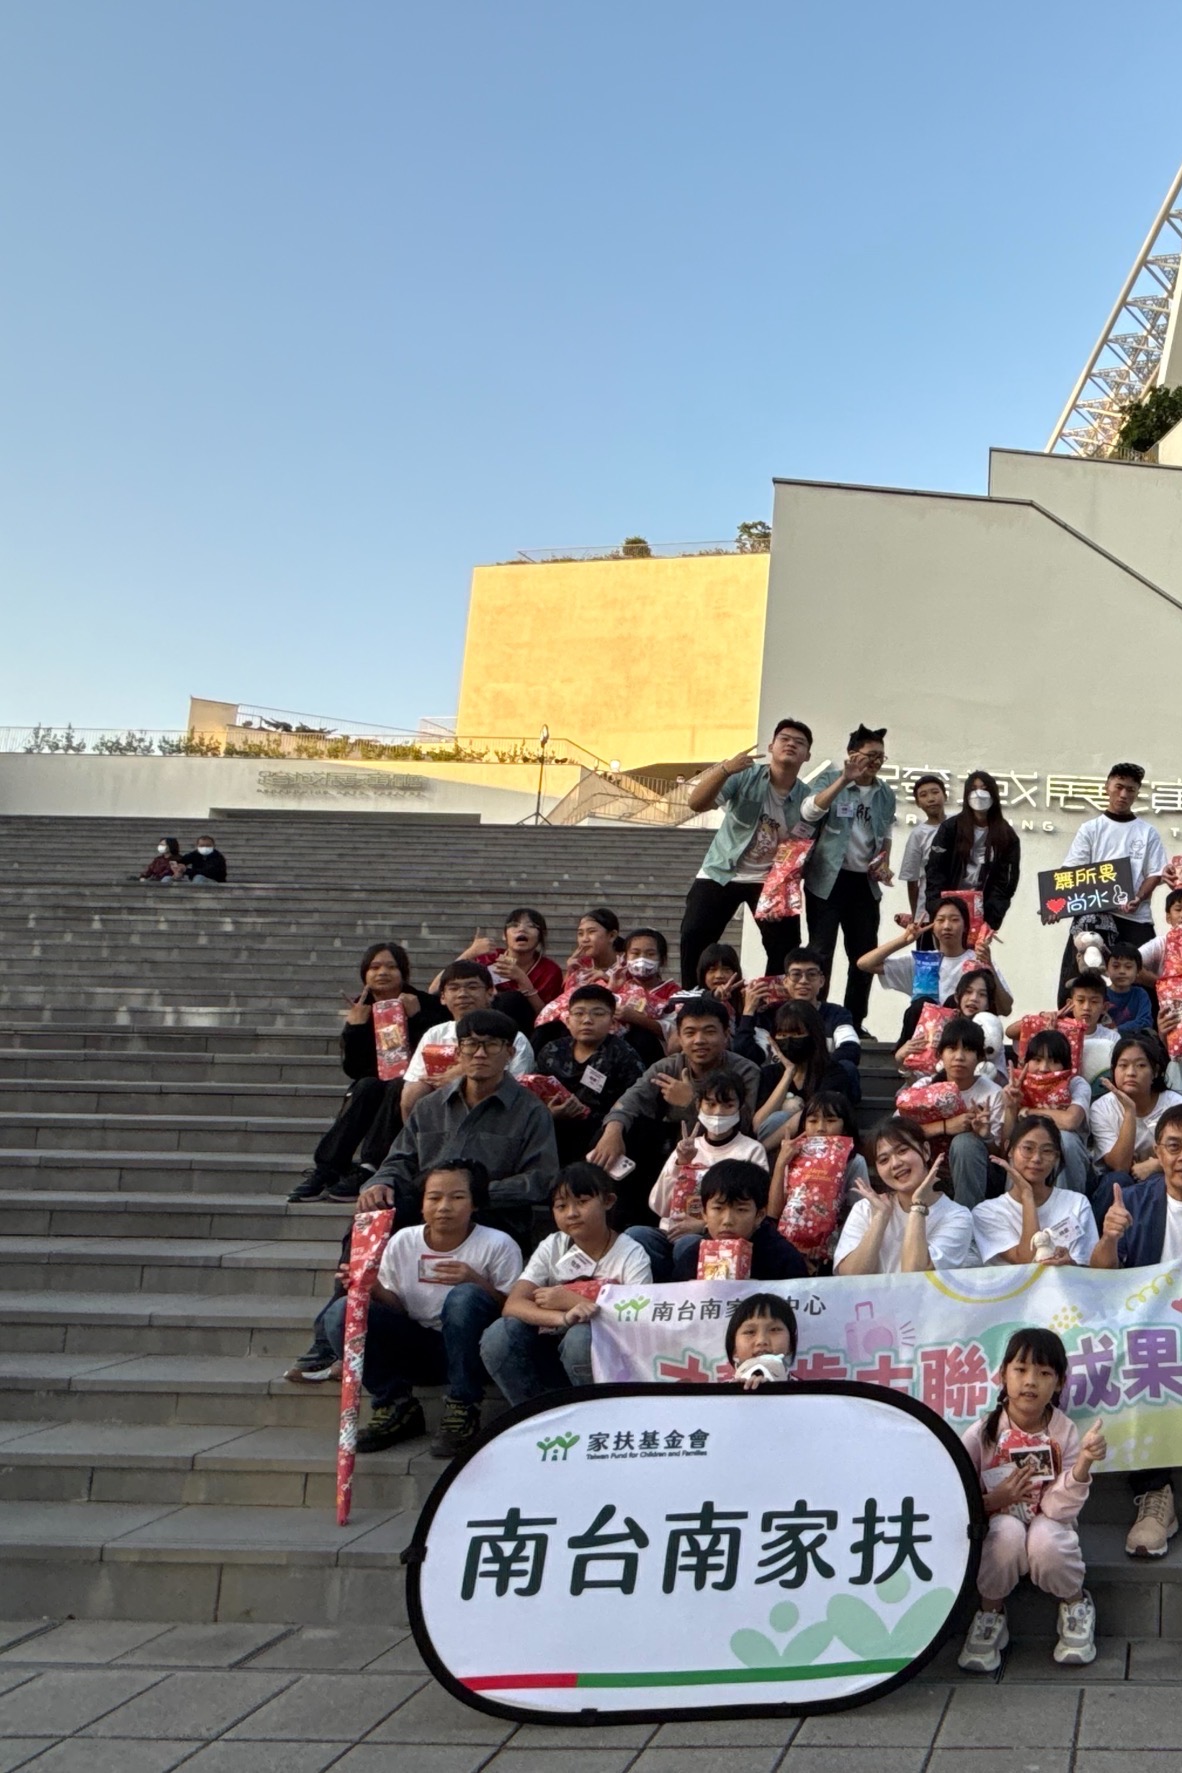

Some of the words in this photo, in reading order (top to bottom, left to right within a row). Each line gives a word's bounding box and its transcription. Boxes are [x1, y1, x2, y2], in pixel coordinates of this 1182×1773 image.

[1066, 889, 1110, 913] 尚水
[651, 1294, 827, 1322] 南台南家中心
[586, 1428, 710, 1451] 家扶基金會
[611, 1452, 627, 1460] Fund
[628, 1451, 638, 1459] for
[639, 1450, 666, 1458] Children
[460, 1496, 934, 1601] 南台南家扶
